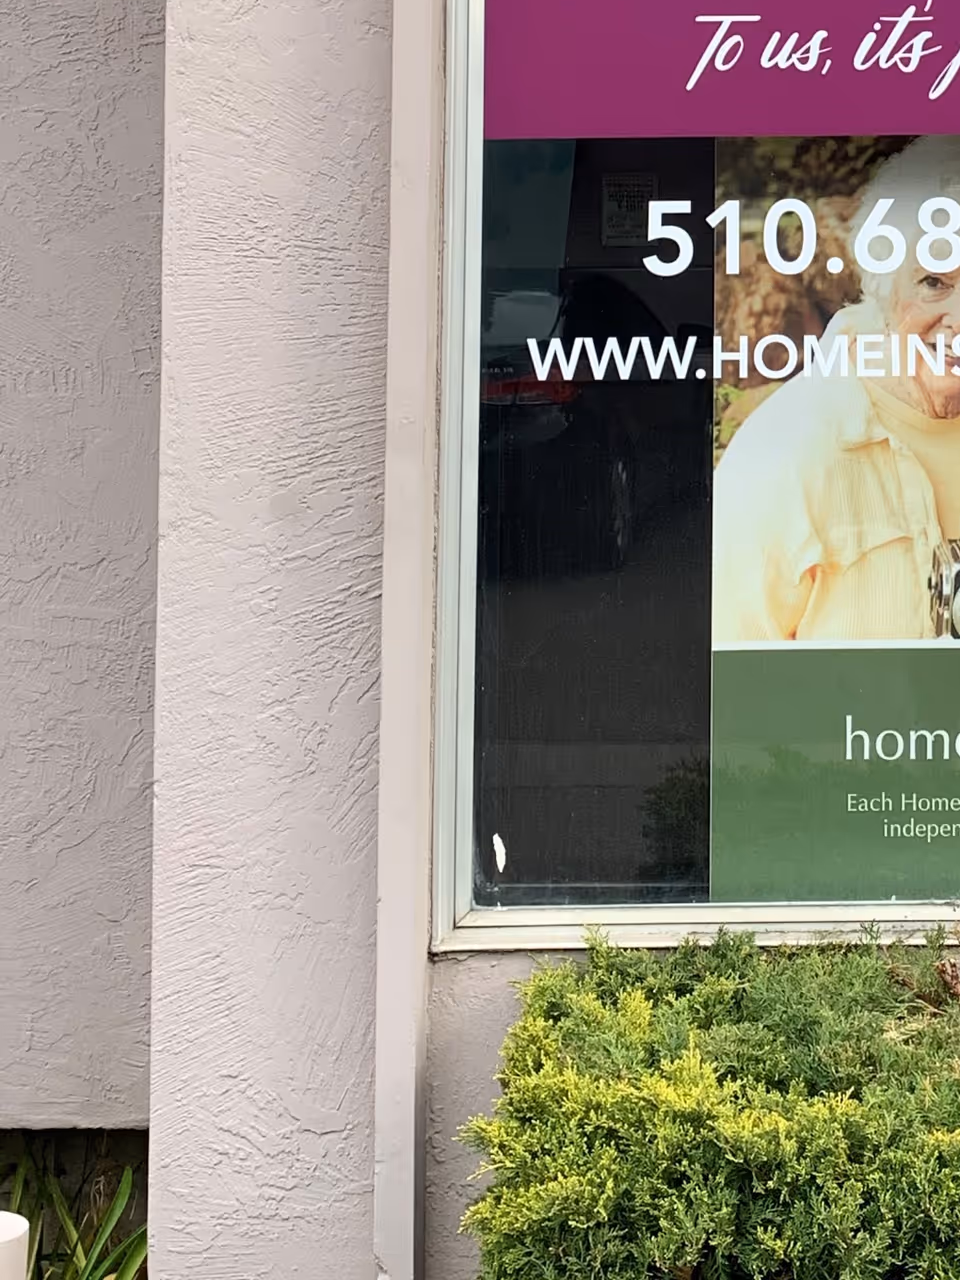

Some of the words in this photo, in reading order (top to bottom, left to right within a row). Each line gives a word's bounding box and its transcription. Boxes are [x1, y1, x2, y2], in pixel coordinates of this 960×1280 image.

[686, 15, 762, 91] To
[760, 27, 832, 75] us,
[847, 792, 893, 812] Each
